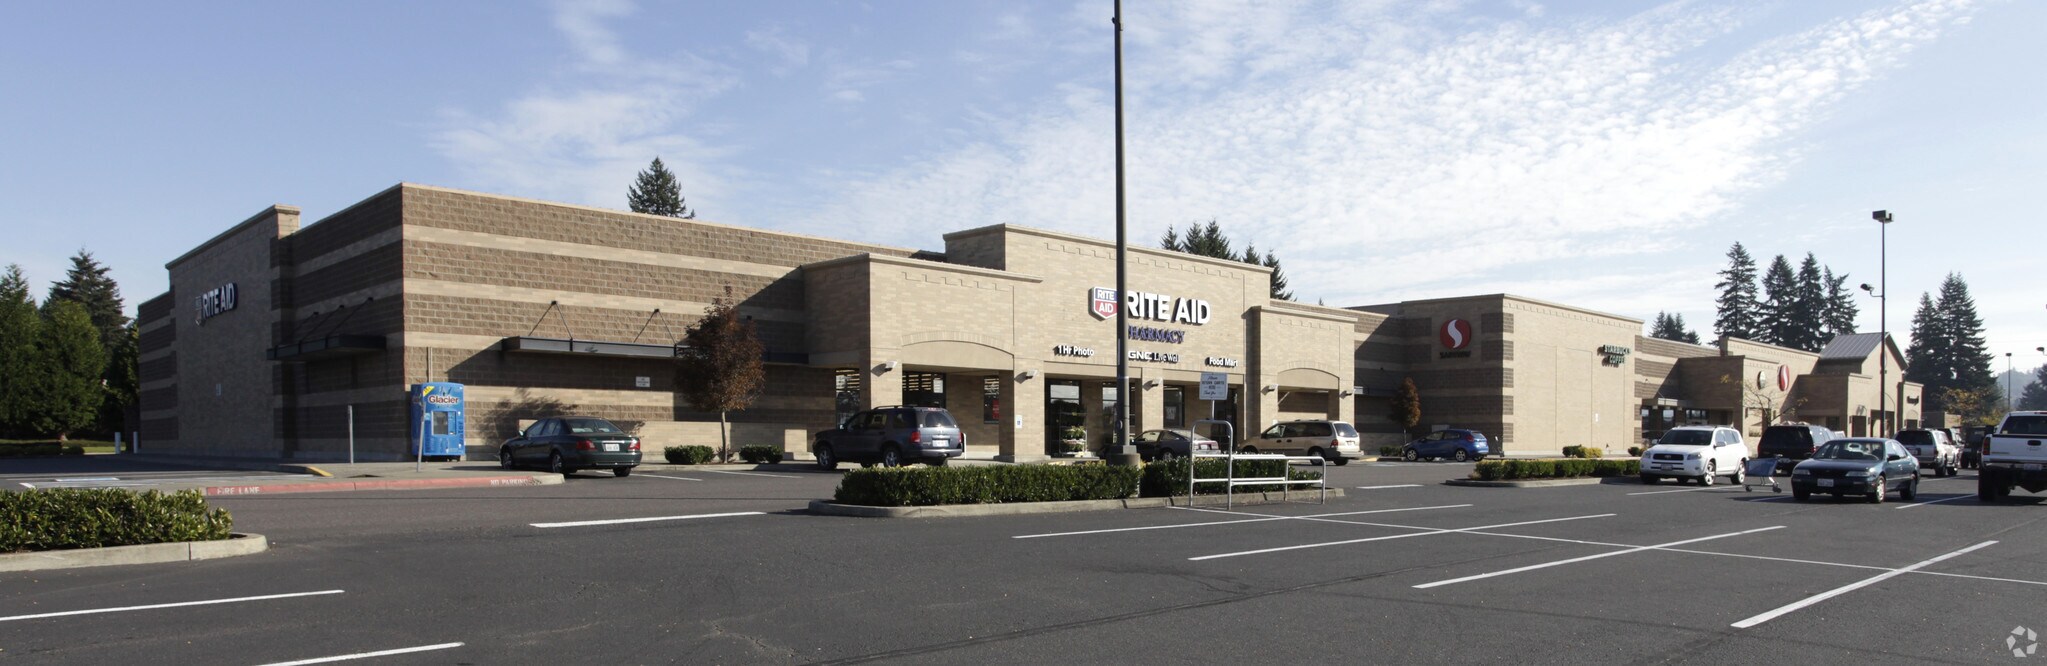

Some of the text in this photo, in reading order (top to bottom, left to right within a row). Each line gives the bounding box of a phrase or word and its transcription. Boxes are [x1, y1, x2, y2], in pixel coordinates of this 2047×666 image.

[1097, 289, 1115, 300] RITE
[202, 288, 219, 319] RITE
[220, 282, 235, 312] AID
[1098, 302, 1114, 313] AID
[1127, 290, 1211, 324] RITE AID
[1128, 325, 1185, 343] HARMACY
[1063, 345, 1073, 355] Hr
[1073, 345, 1095, 356] Photo
[1127, 350, 1153, 360] GNC
[1210, 356, 1239, 367] Food Mart
[428, 395, 459, 404] Glacier
